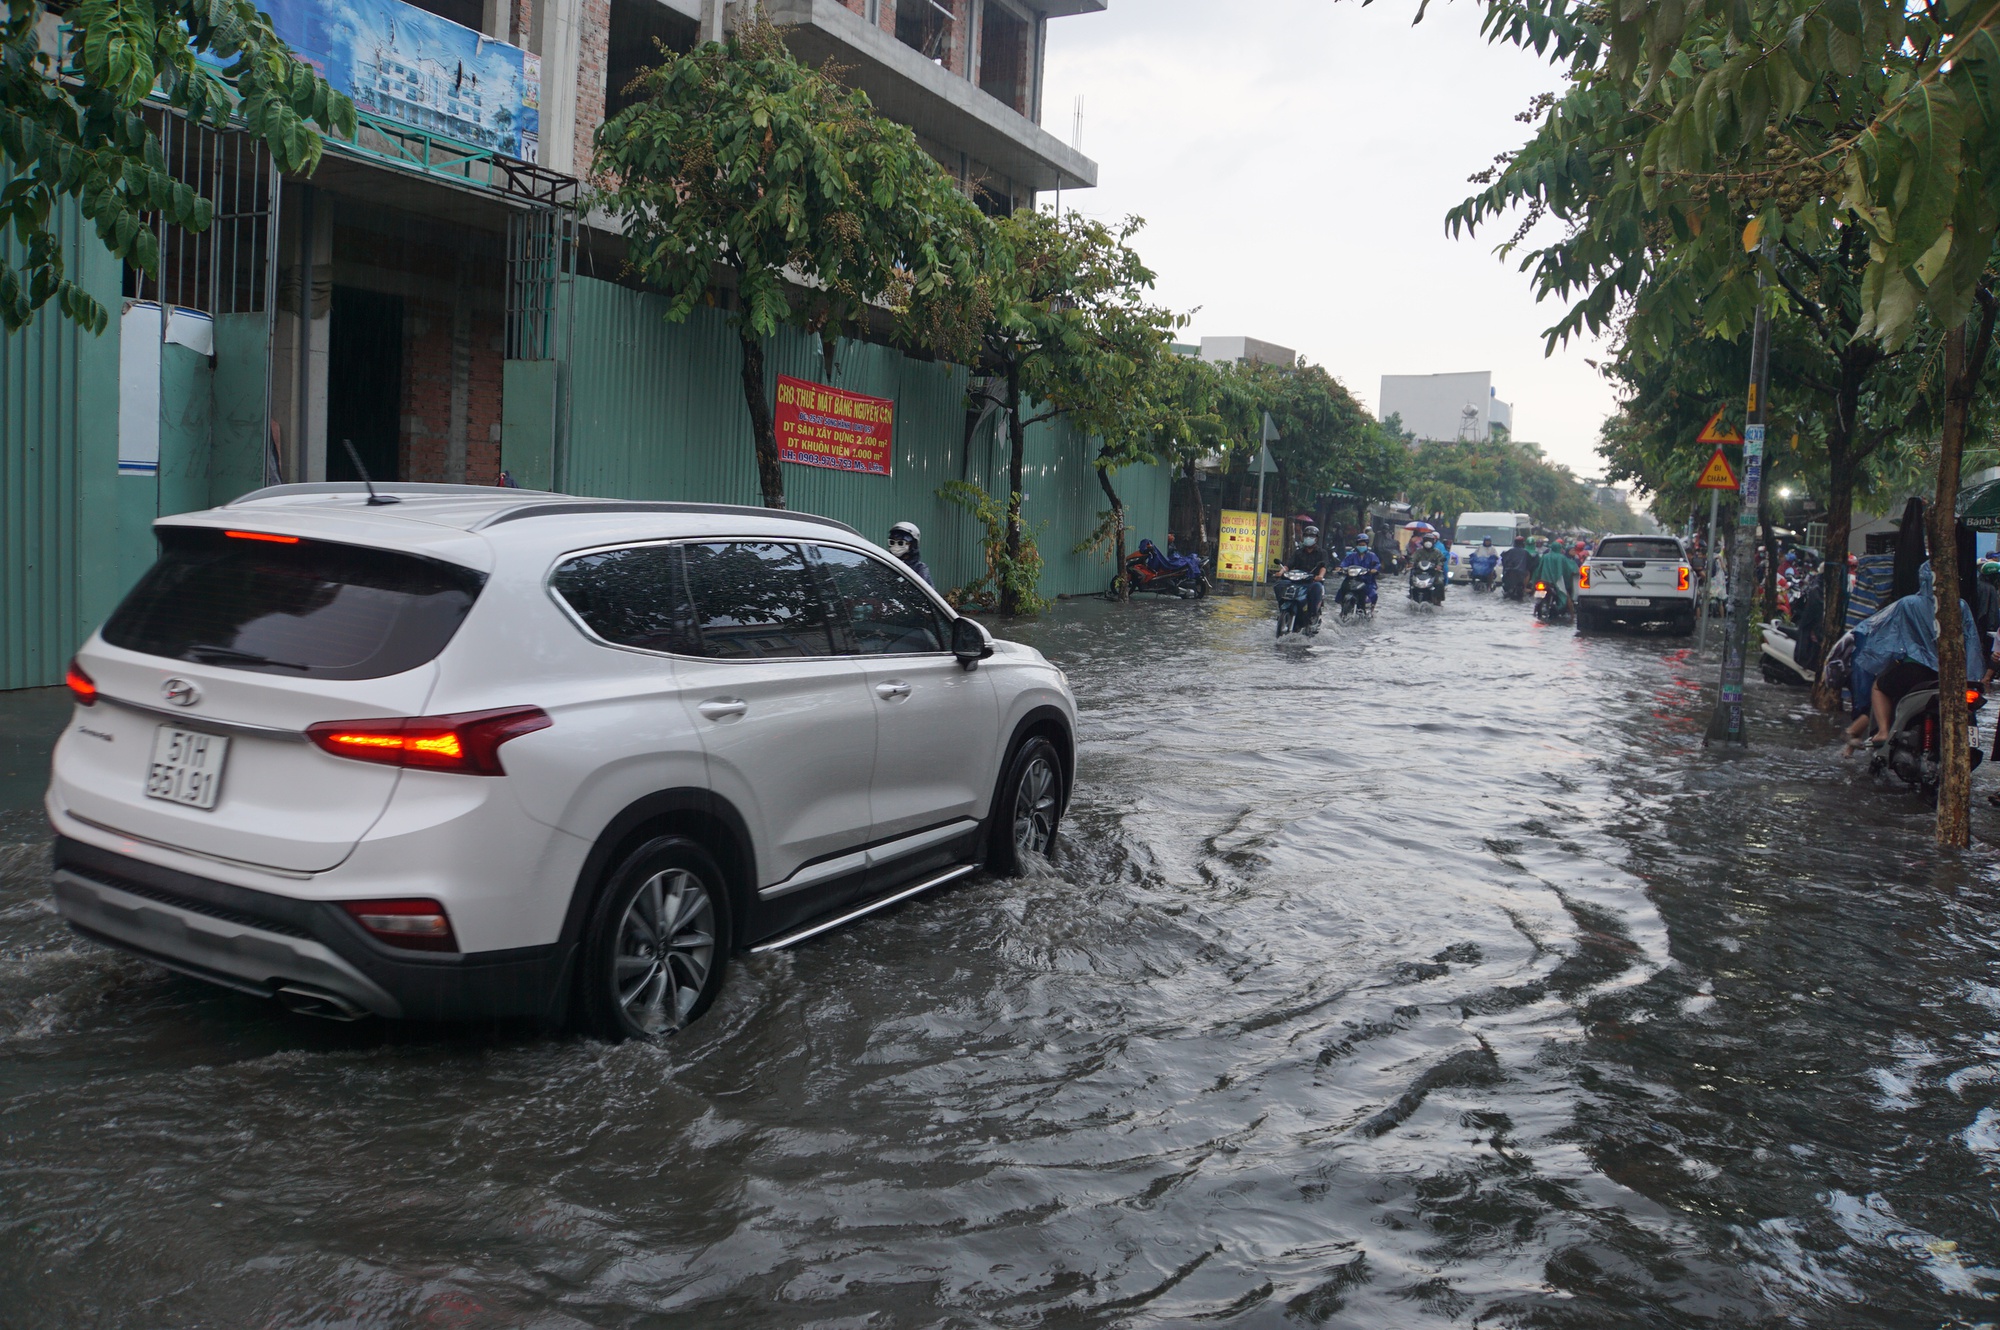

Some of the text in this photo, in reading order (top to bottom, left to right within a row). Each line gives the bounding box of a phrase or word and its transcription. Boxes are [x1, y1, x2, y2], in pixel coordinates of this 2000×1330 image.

[778, 383, 794, 404] CHO
[796, 387, 815, 409] THUÊ
[854, 400, 878, 422] NGUYÊN
[784, 421, 794, 432] DT
[816, 426, 832, 440] XÂY
[834, 432, 854, 445] DỰNG
[788, 437, 799, 448] DT
[802, 440, 829, 454] KHUÔN
[832, 443, 850, 456] VIÊN
[782, 449, 796, 460] LH:
[798, 452, 852, 469] 0903.979.753
[854, 460, 867, 471] Ms.
[1220, 526, 1236, 534] CƠM
[1252, 528, 1266, 536] XO
[1966, 516, 1992, 526] Bánh
[167, 732, 209, 768] 51H
[146, 763, 213, 804] 551.91
